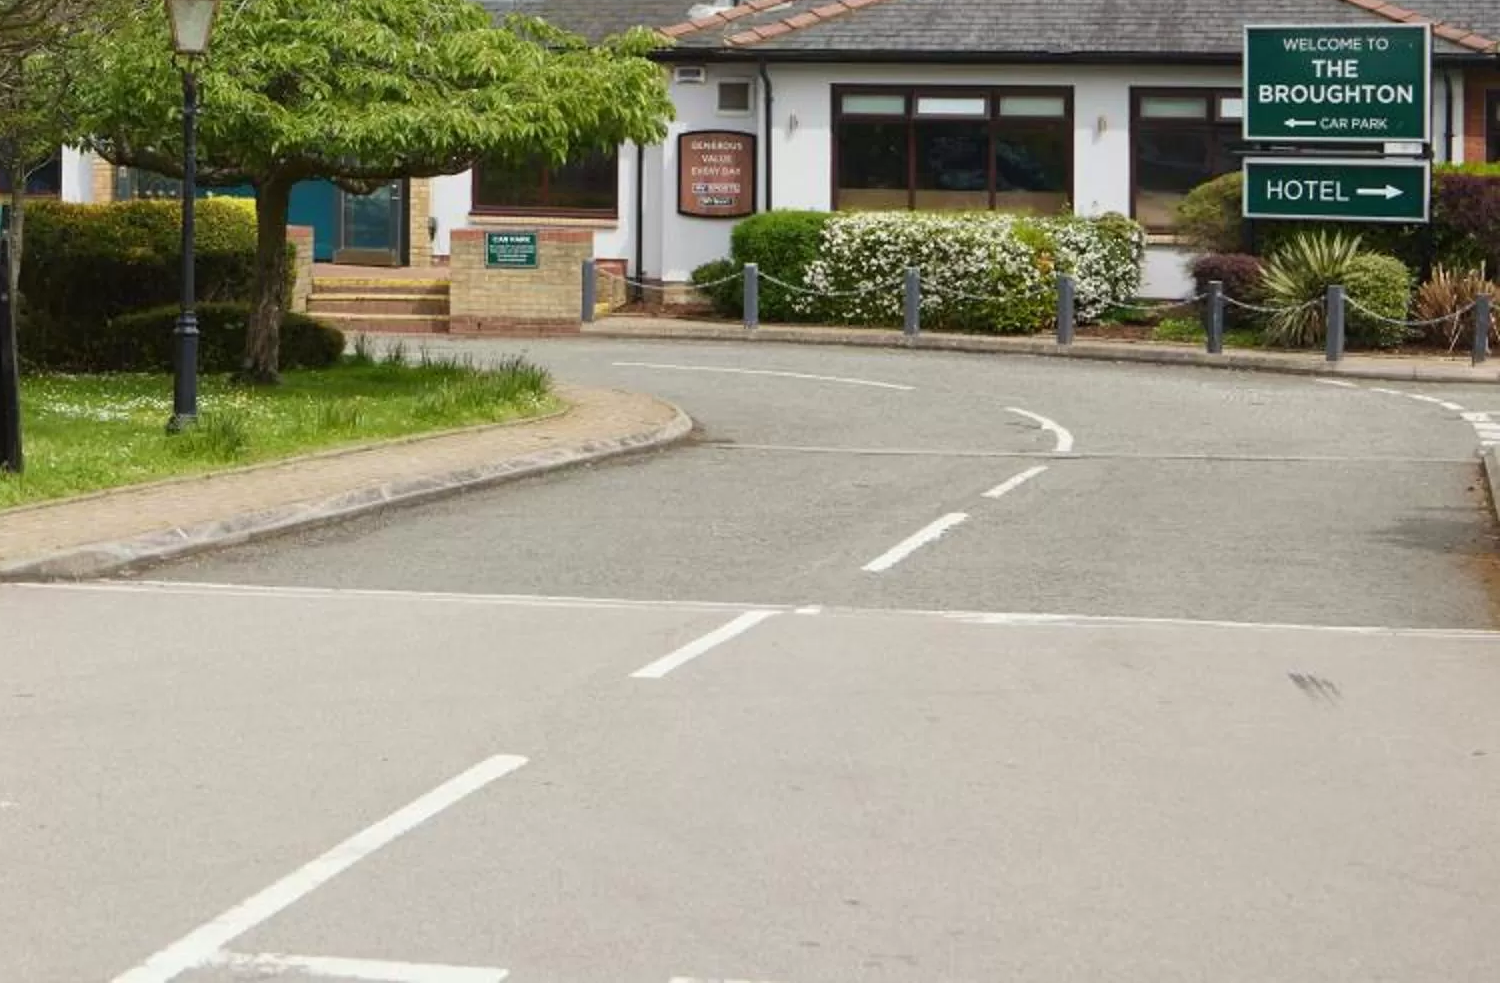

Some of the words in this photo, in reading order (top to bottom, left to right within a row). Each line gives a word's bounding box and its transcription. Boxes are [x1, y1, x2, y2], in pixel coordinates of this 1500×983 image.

[1283, 38, 1362, 52] WELCOME
[1367, 38, 1389, 51] TO
[1311, 59, 1359, 78] THE
[1258, 84, 1413, 104] BROUGHTON
[1319, 117, 1347, 130] CAR
[1350, 118, 1388, 130] PARK
[1266, 180, 1350, 202] HOTEL
